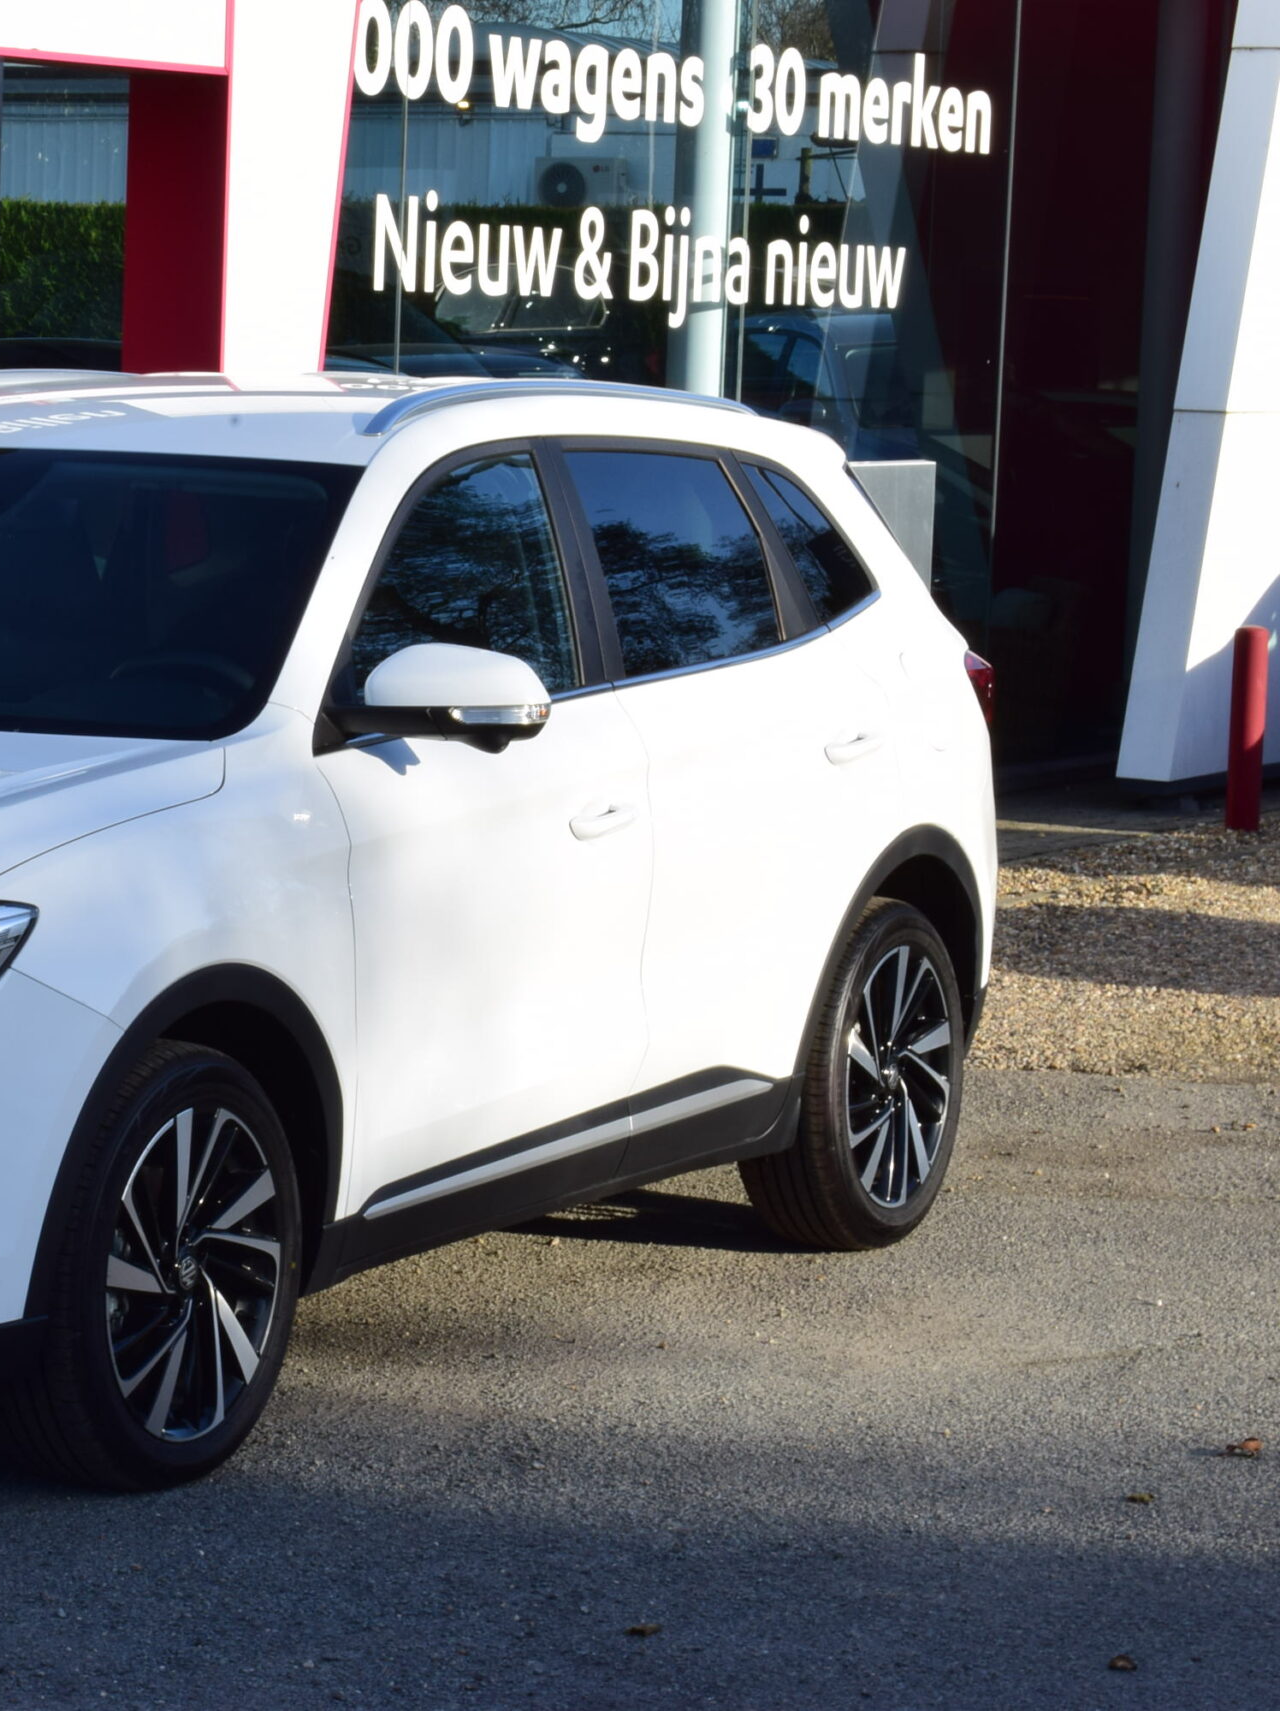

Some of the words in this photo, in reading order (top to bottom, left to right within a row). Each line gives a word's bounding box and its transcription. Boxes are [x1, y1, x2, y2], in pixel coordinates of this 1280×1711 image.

[489, 34, 705, 143] wagens
[747, 43, 806, 136] 30
[818, 53, 991, 154] merken
[373, 189, 563, 298] Nieuw
[574, 206, 614, 300] &
[628, 206, 749, 329] Bijna
[766, 214, 907, 309] nieuw
